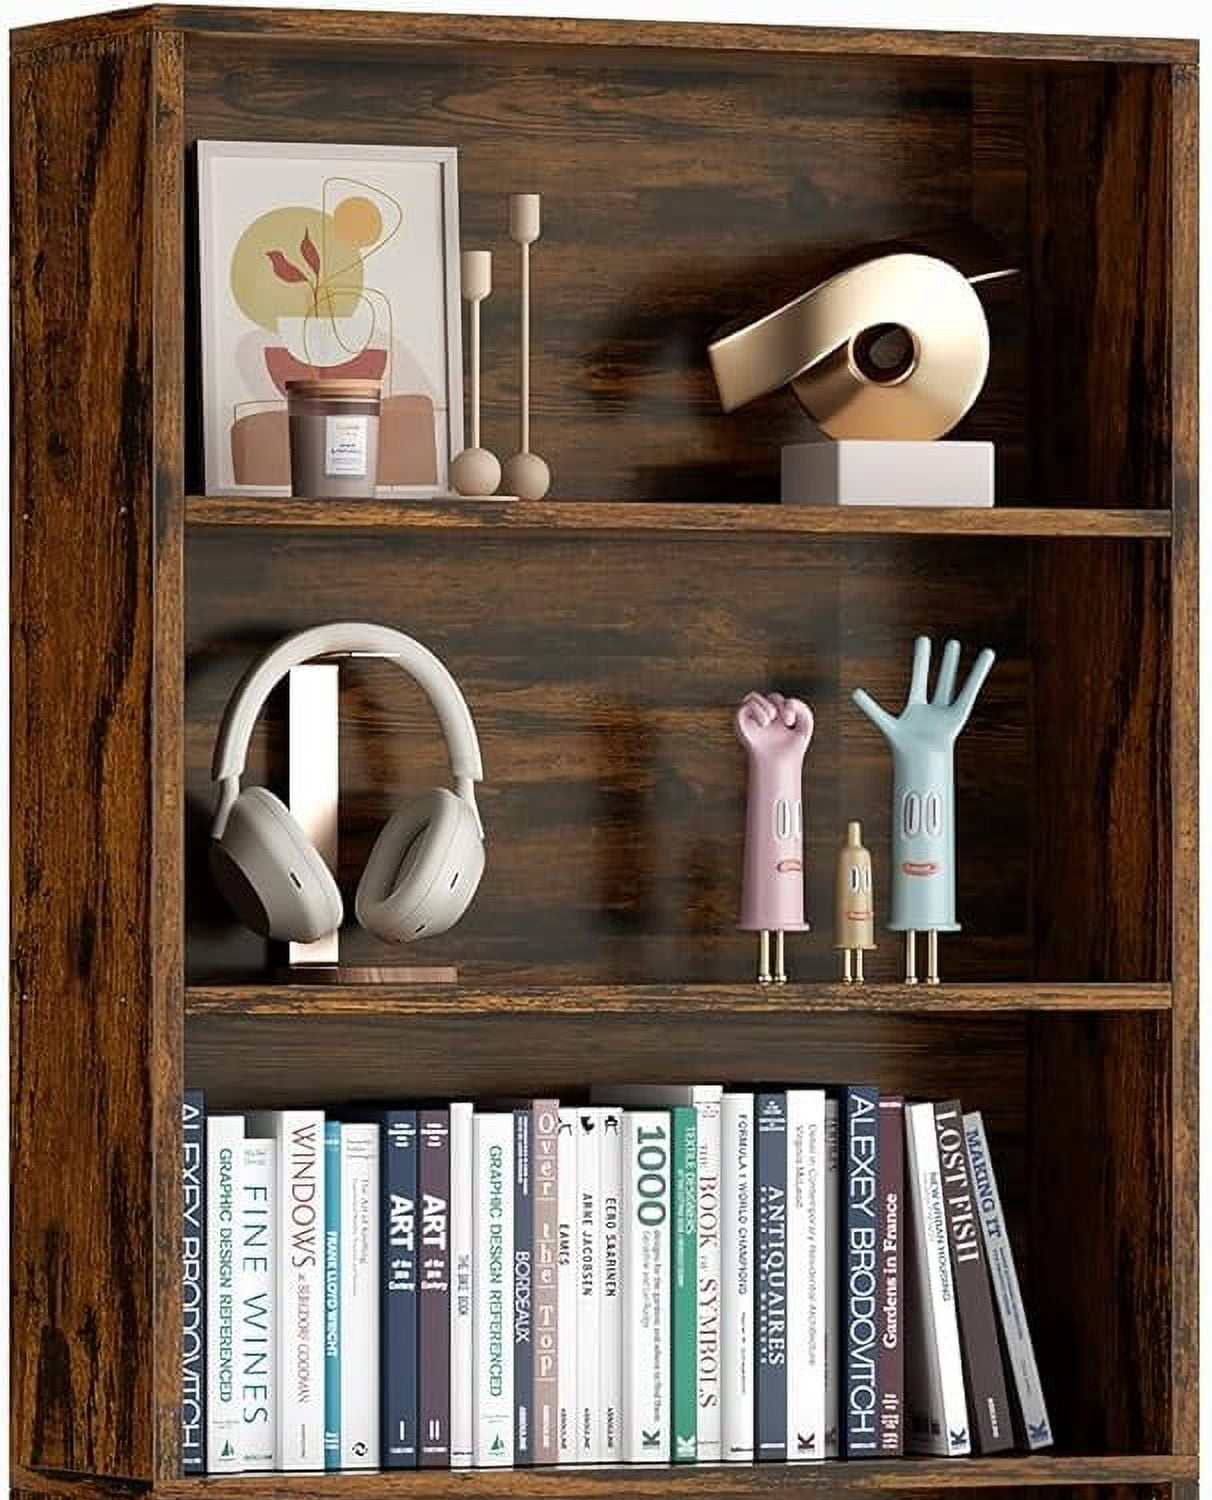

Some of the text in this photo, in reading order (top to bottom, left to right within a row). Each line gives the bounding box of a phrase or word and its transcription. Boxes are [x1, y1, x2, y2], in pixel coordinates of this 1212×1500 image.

[538, 1113, 554, 1198] Over
[636, 1125, 667, 1227] 1000
[738, 1114, 748, 1170] FORMULA
[849, 1094, 875, 1217] ALEXEY
[935, 1109, 979, 1265] LOST FISH
[965, 1127, 1001, 1240] MAKING IT
[243, 1186, 268, 1273] FINE
[291, 1123, 316, 1268] WINDOWS
[390, 1194, 414, 1250] ART
[423, 1194, 446, 1250] ART
[559, 1224, 570, 1266] EAMES
[582, 1193, 593, 1297] ARNE JACOBSEN
[699, 1176, 718, 1248] BOOK
[738, 1182, 748, 1224] WORLD
[219, 1148, 232, 1402] GRAPHIC DESIGN REFERENCED
[326, 1231, 338, 1269] FRANK
[326, 1271, 338, 1308] LLOYD
[489, 1145, 502, 1397] GRAPHIC DESIGN REFERENCED
[515, 1251, 530, 1343] BORDEAUX
[605, 1198, 618, 1297] EERO SAARINEN
[765, 1185, 785, 1366] ANTIQUAIRES
[883, 1193, 899, 1349] Gardens in France
[243, 1294, 268, 1424] WINES
[538, 1305, 554, 1377] Top
[699, 1278, 718, 1409] SYMBOLS
[849, 1227, 875, 1433] BRODOVITCH
